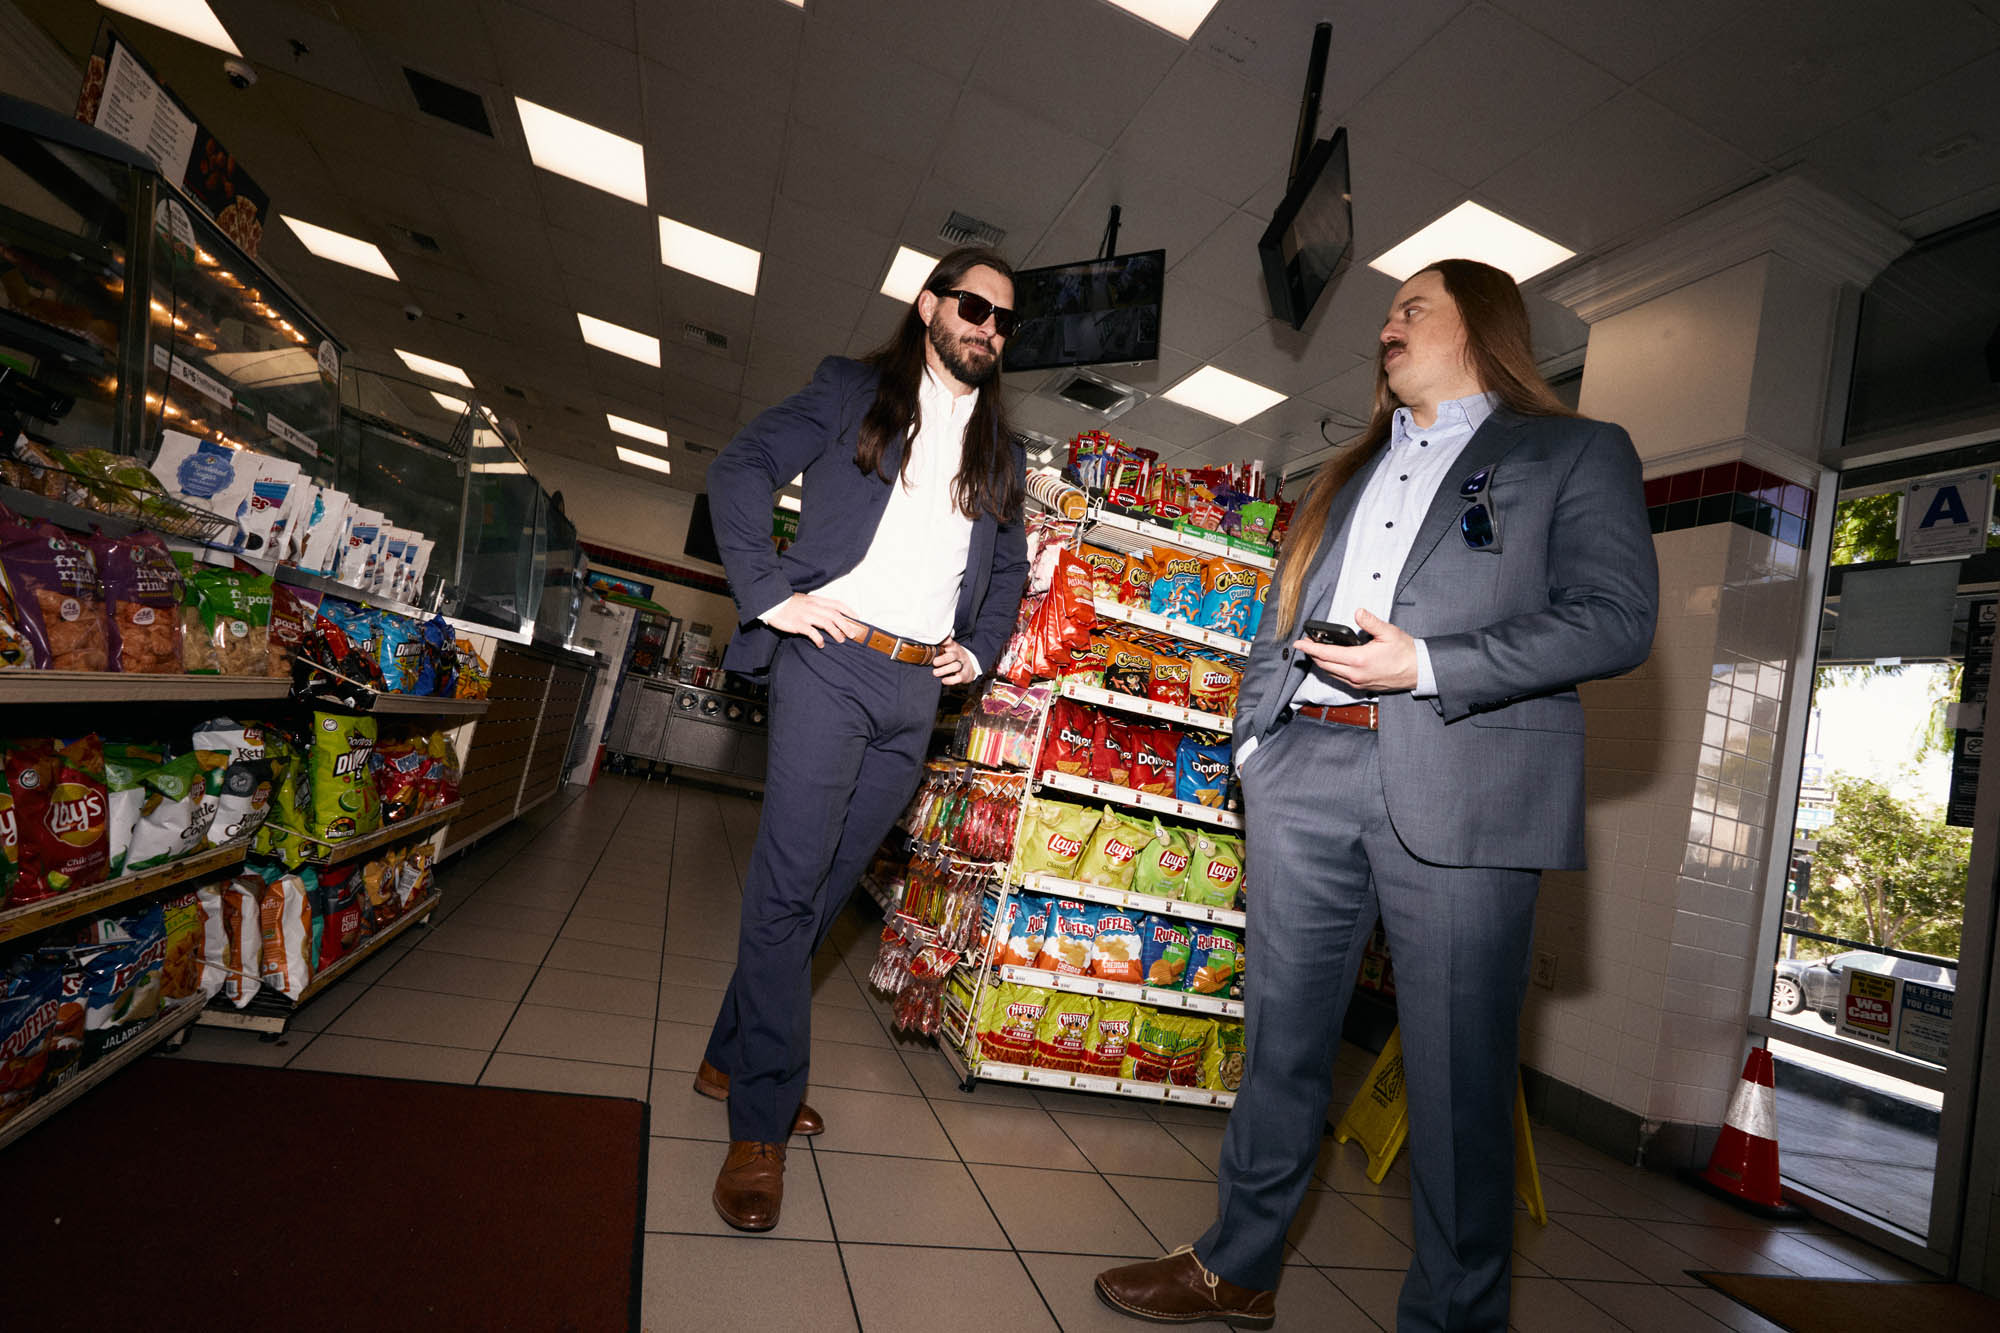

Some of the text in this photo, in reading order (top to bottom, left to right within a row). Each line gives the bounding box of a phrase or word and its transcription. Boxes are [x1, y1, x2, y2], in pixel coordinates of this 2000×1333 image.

[1920, 486, 1969, 528] A
[1086, 554, 1124, 574] Cheetos
[1130, 569, 1151, 587] Chee
[1215, 570, 1257, 594] Cheetos
[1116, 652, 1151, 668] Cheetos
[1203, 672, 1232, 686] Fritos
[348, 736, 374, 746] Doritos
[1138, 752, 1174, 767] Doritos
[1192, 761, 1229, 775] Doritos
[50, 795, 102, 833] Lay's
[1049, 834, 1081, 857] Lay's
[1105, 839, 1135, 860] Lay's
[1160, 851, 1187, 871] Lay's
[1209, 861, 1237, 882] Lay's
[1057, 915, 1095, 939] RUFFLES
[1097, 916, 1135, 934] UFFLES
[1153, 927, 1190, 948] RUFFLE
[1197, 934, 1236, 953] RUFFLES
[109, 937, 167, 996] RUFFLE
[1855, 998, 1882, 1011] We
[1906, 998, 1922, 1009] YOU
[1057, 1013, 1089, 1030] CHESTER'S
[1847, 1006, 1888, 1023] Card
[0, 999, 59, 1058] RUFFLES
[102, 1021, 142, 1049] JALAPE
[1013, 1031, 1031, 1039] FRIES
[1137, 1020, 1177, 1048] FUNYUN
